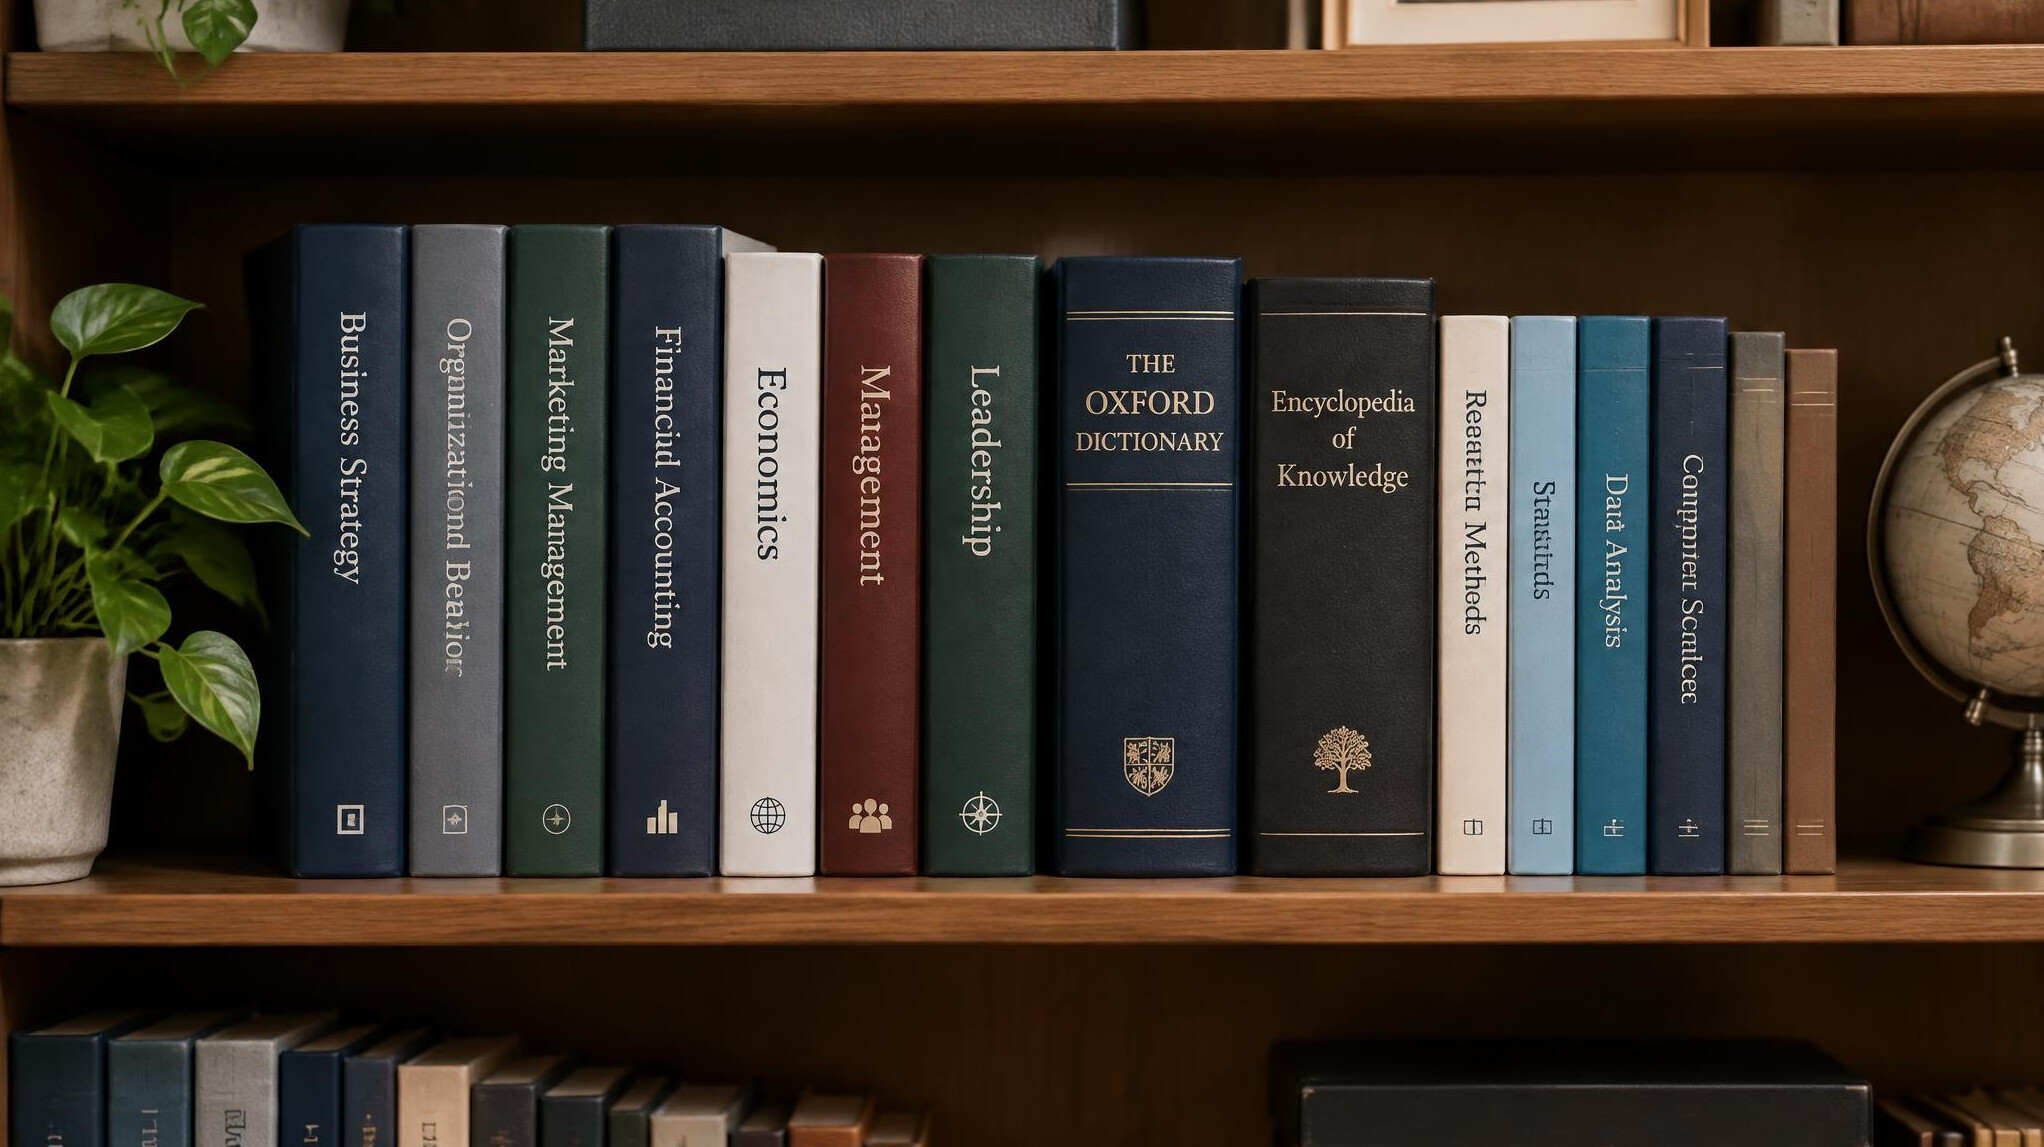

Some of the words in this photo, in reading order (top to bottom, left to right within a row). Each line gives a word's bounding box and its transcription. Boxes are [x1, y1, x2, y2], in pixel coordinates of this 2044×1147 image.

[340, 311, 368, 446] Business
[540, 316, 574, 473] Marketing
[1085, 390, 1215, 415] OXFORD
[1125, 354, 1176, 374] THE
[1271, 388, 1416, 419] Encyclopedia
[757, 366, 787, 561] Economics
[961, 364, 1002, 557] Leadership
[1075, 431, 1225, 452] DICTIONARY
[1277, 463, 1409, 493] Knowledge
[1332, 426, 1357, 450] of
[333, 457, 368, 585] Strategy
[540, 482, 574, 672] Management
[646, 476, 681, 649] Accounting
[1599, 539, 1628, 648] Analysis
